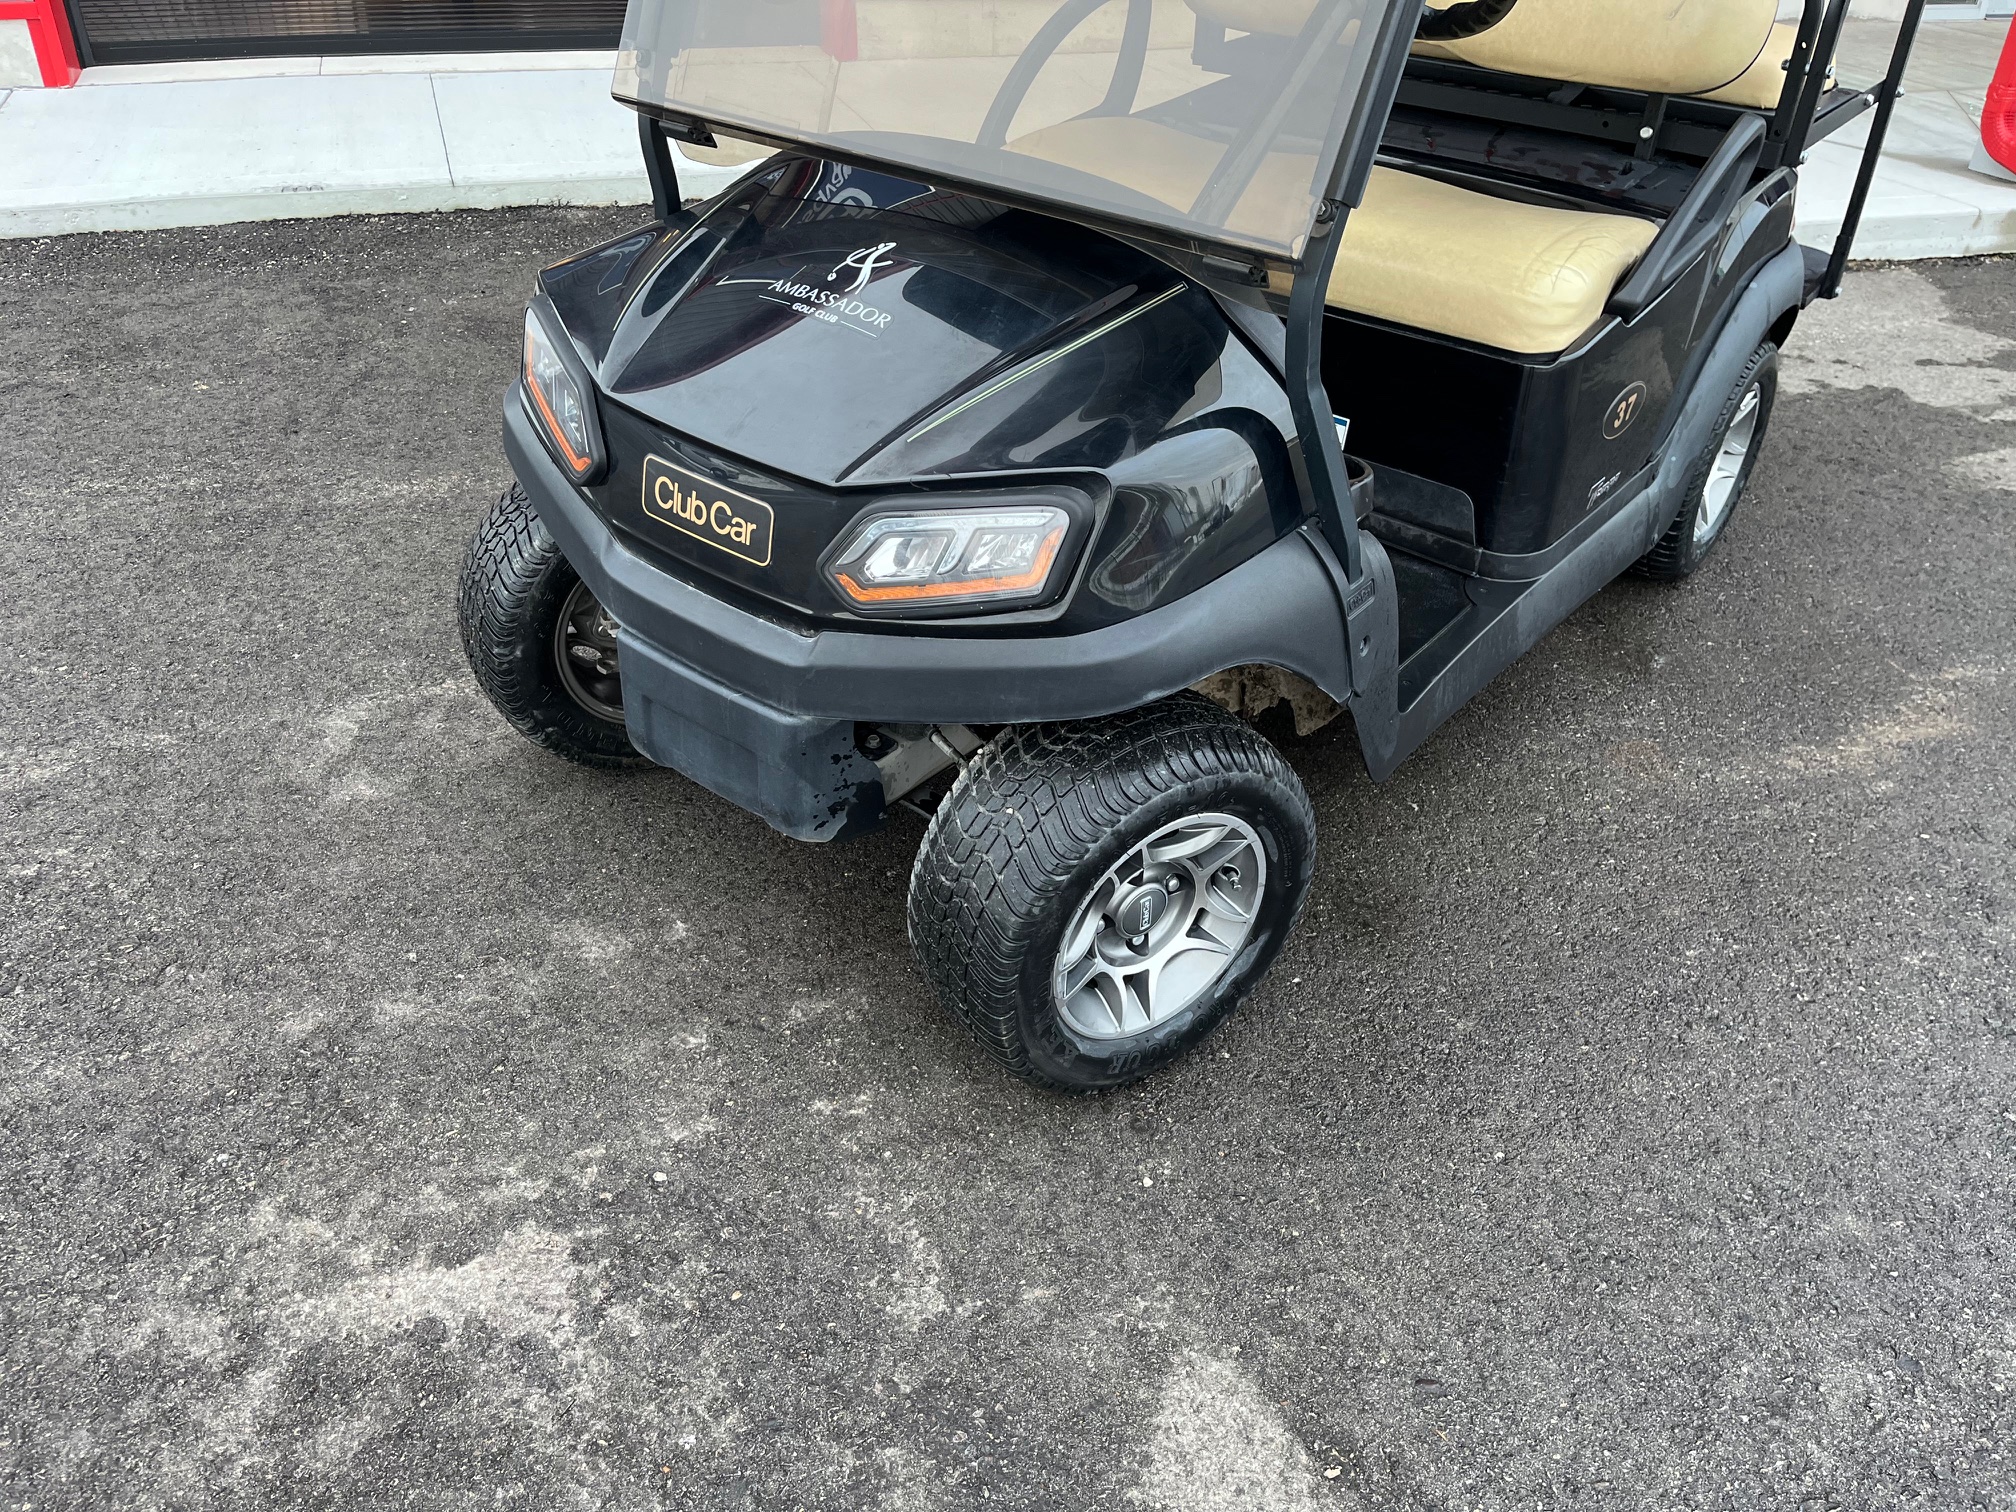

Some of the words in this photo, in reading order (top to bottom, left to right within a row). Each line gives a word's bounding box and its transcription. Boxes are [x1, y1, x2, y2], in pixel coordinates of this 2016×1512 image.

[768, 279, 892, 329] AMBASSADOR
[792, 302, 816, 317] GOLF
[814, 309, 839, 323] CLUB
[1613, 392, 1638, 429] 37
[654, 475, 708, 526] Club
[709, 500, 757, 546] Car
